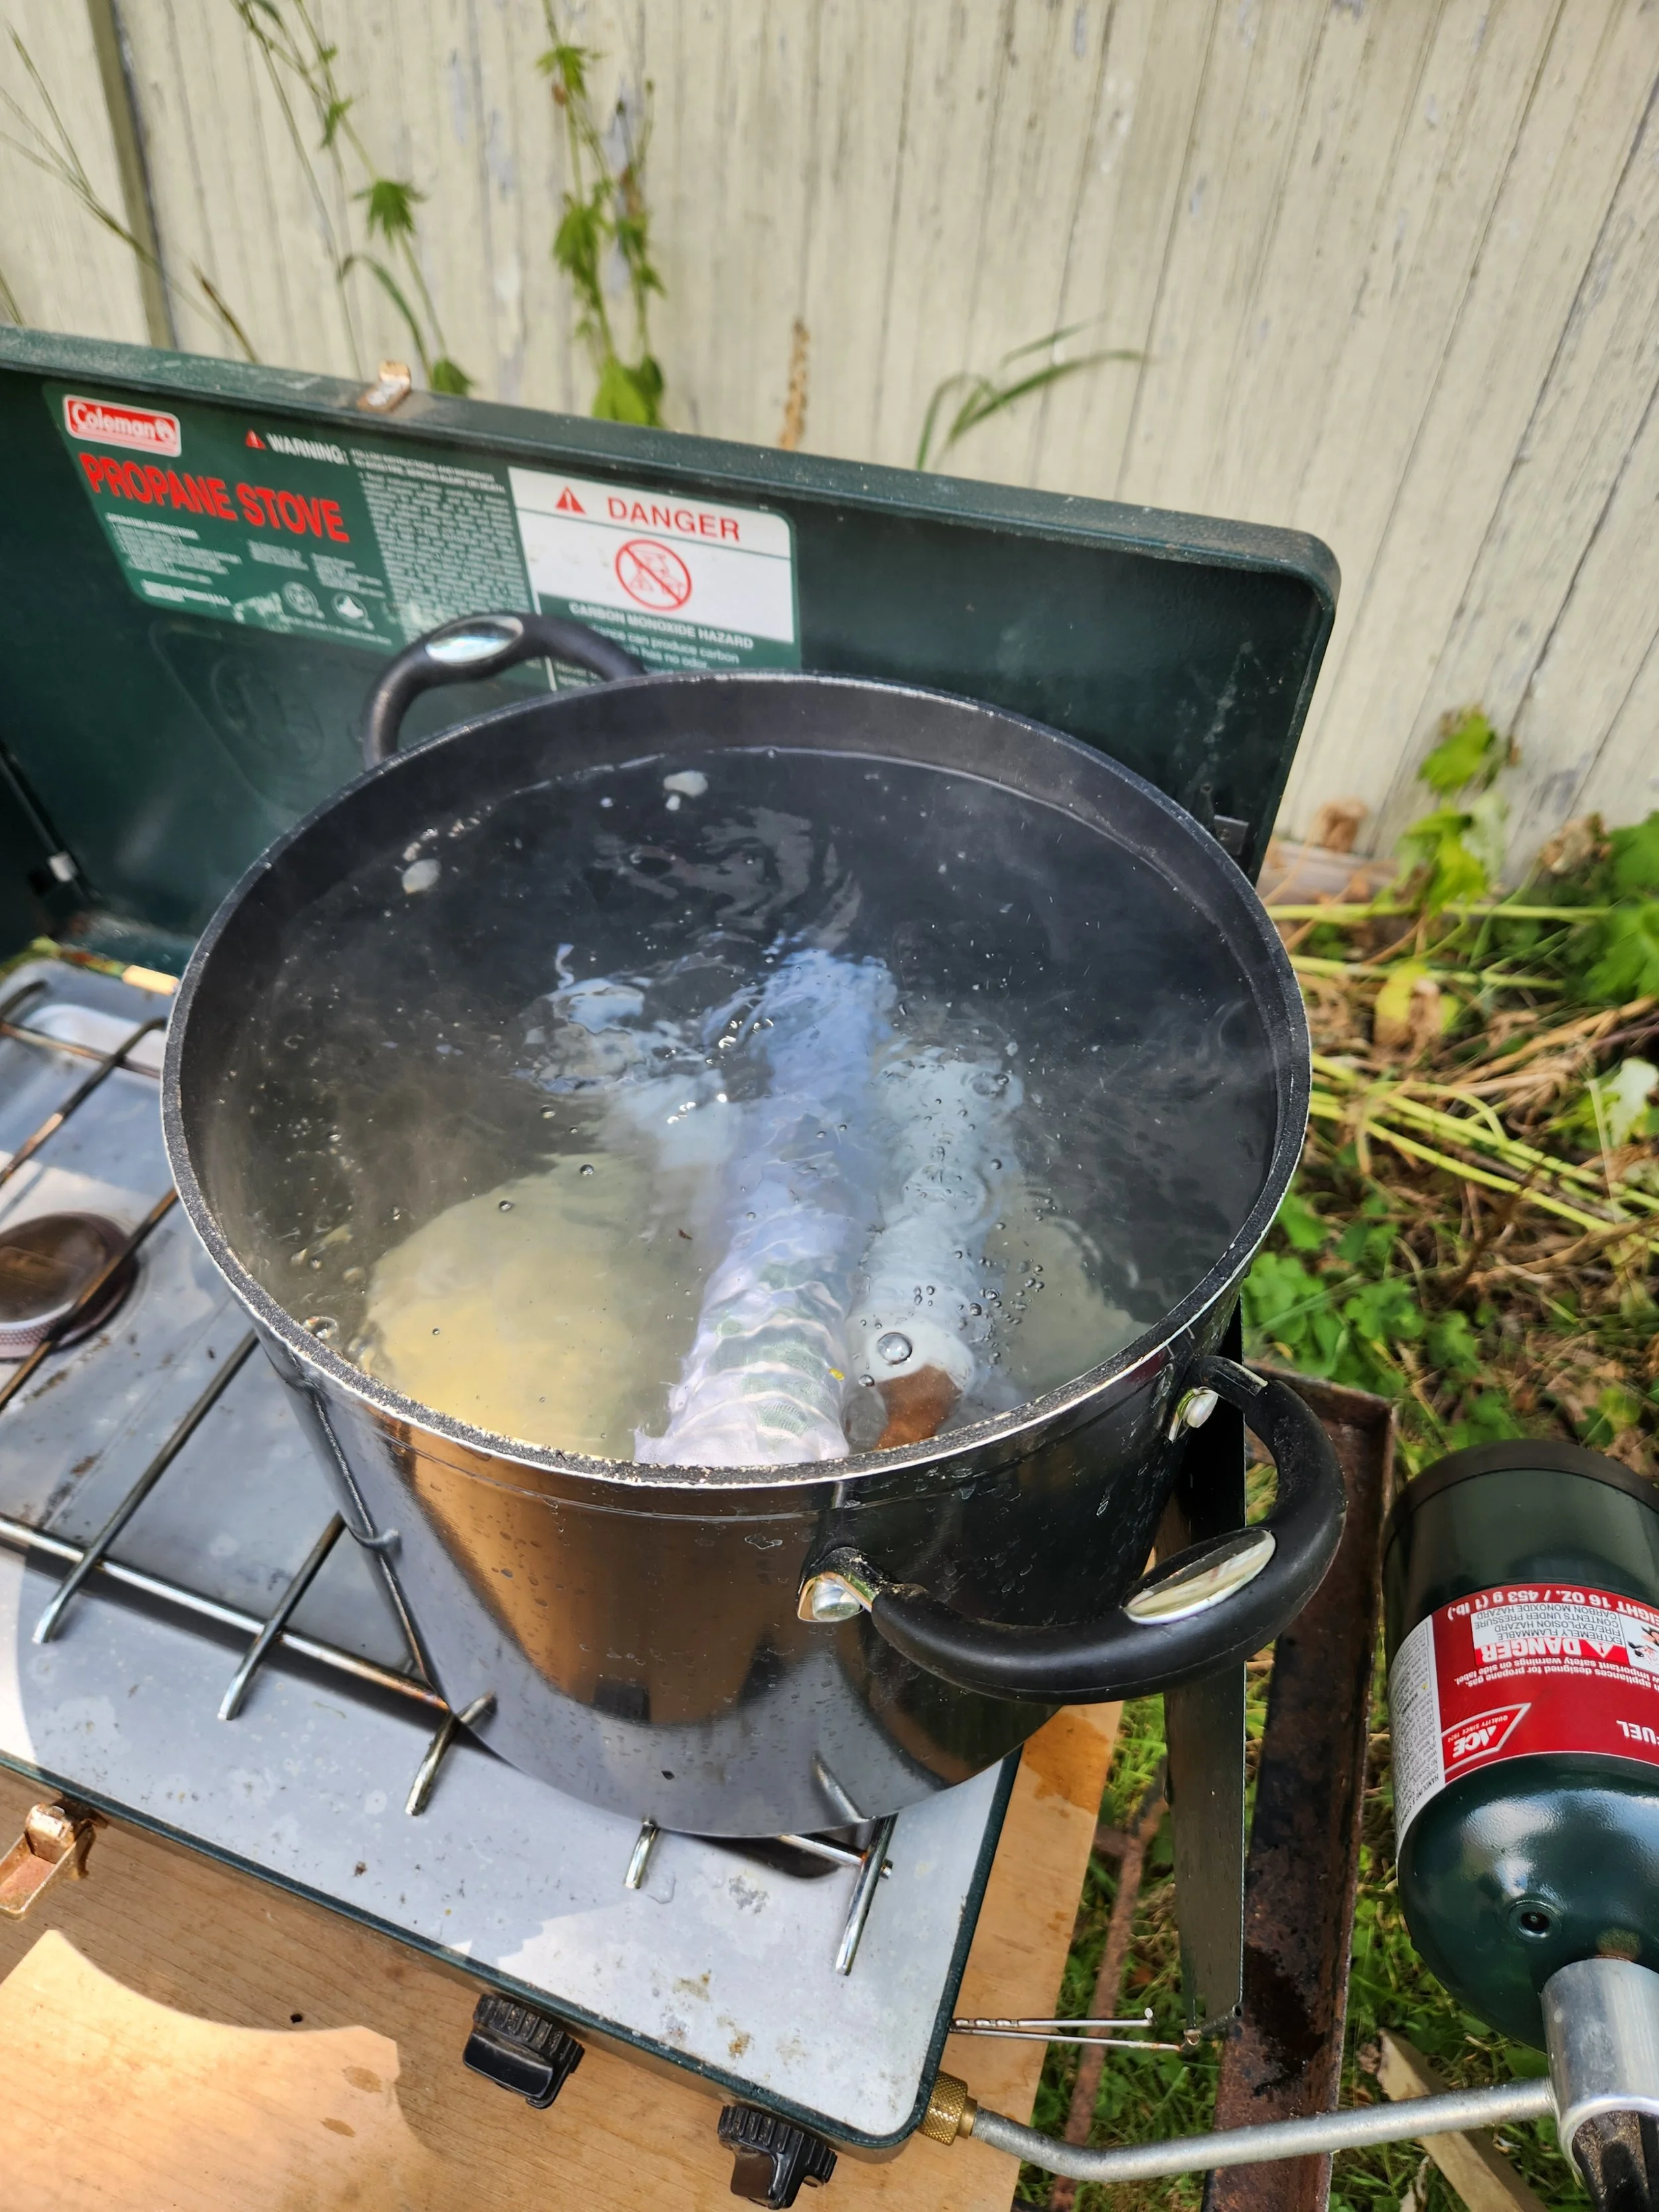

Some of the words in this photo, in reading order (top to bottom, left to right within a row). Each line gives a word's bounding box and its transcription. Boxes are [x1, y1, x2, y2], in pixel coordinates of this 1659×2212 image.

[72, 403, 155, 440] Coleman
[78, 452, 239, 522] PROPANE
[236, 482, 350, 543] STOVE
[607, 496, 741, 543] DANGER
[569, 601, 626, 625] CARBON
[626, 613, 697, 638] MONOXIDE
[697, 627, 754, 649] HAZARD
[626, 632, 650, 646] can
[650, 636, 697, 656] produce
[698, 646, 741, 664] carbon
[640, 645, 663, 661] has
[664, 652, 680, 665] no
[1475, 1594, 1488, 1611] (1
[1492, 1591, 1504, 1603] g
[1507, 1590, 1539, 1603] 453
[1544, 1589, 1551, 1601] /
[1555, 1590, 1585, 1604] OZ.
[1589, 1594, 1611, 1609] 16
[1447, 1601, 1471, 1621] lb.)
[1477, 1607, 1514, 1620] HAZARD
[1517, 1603, 1571, 1613] MONOXIDE
[1573, 1605, 1617, 1620] CARBON
[1475, 1613, 1523, 1630] PRESSURE
[1527, 1611, 1561, 1621] UNDER
[1563, 1611, 1619, 1628] CONTENTS
[1494, 1621, 1534, 1633] HAZARD
[1537, 1619, 1621, 1637] FIRE/EXPLOSION
[1497, 1629, 1558, 1641] FLAMMABLE
[1561, 1628, 1623, 1645] EXTREMELY
[1480, 1637, 1582, 1664] DANGER
[1479, 1664, 1498, 1674] side
[1500, 1660, 1512, 1669] on
[1514, 1657, 1562, 1666] warnings
[1564, 1657, 1597, 1666] safety
[1454, 1668, 1477, 1686] label.
[1486, 1666, 1526, 1682] propane
[1527, 1666, 1542, 1675] for
[1544, 1665, 1593, 1676] designed
[1595, 1668, 1651, 1688] appliances
[1599, 1660, 1650, 1682] important
[1465, 1673, 1484, 1687] gas.
[1480, 1714, 1508, 1727] QUALITY
[1462, 1724, 1480, 1735] SINCE
[1452, 1725, 1497, 1759] ACE
